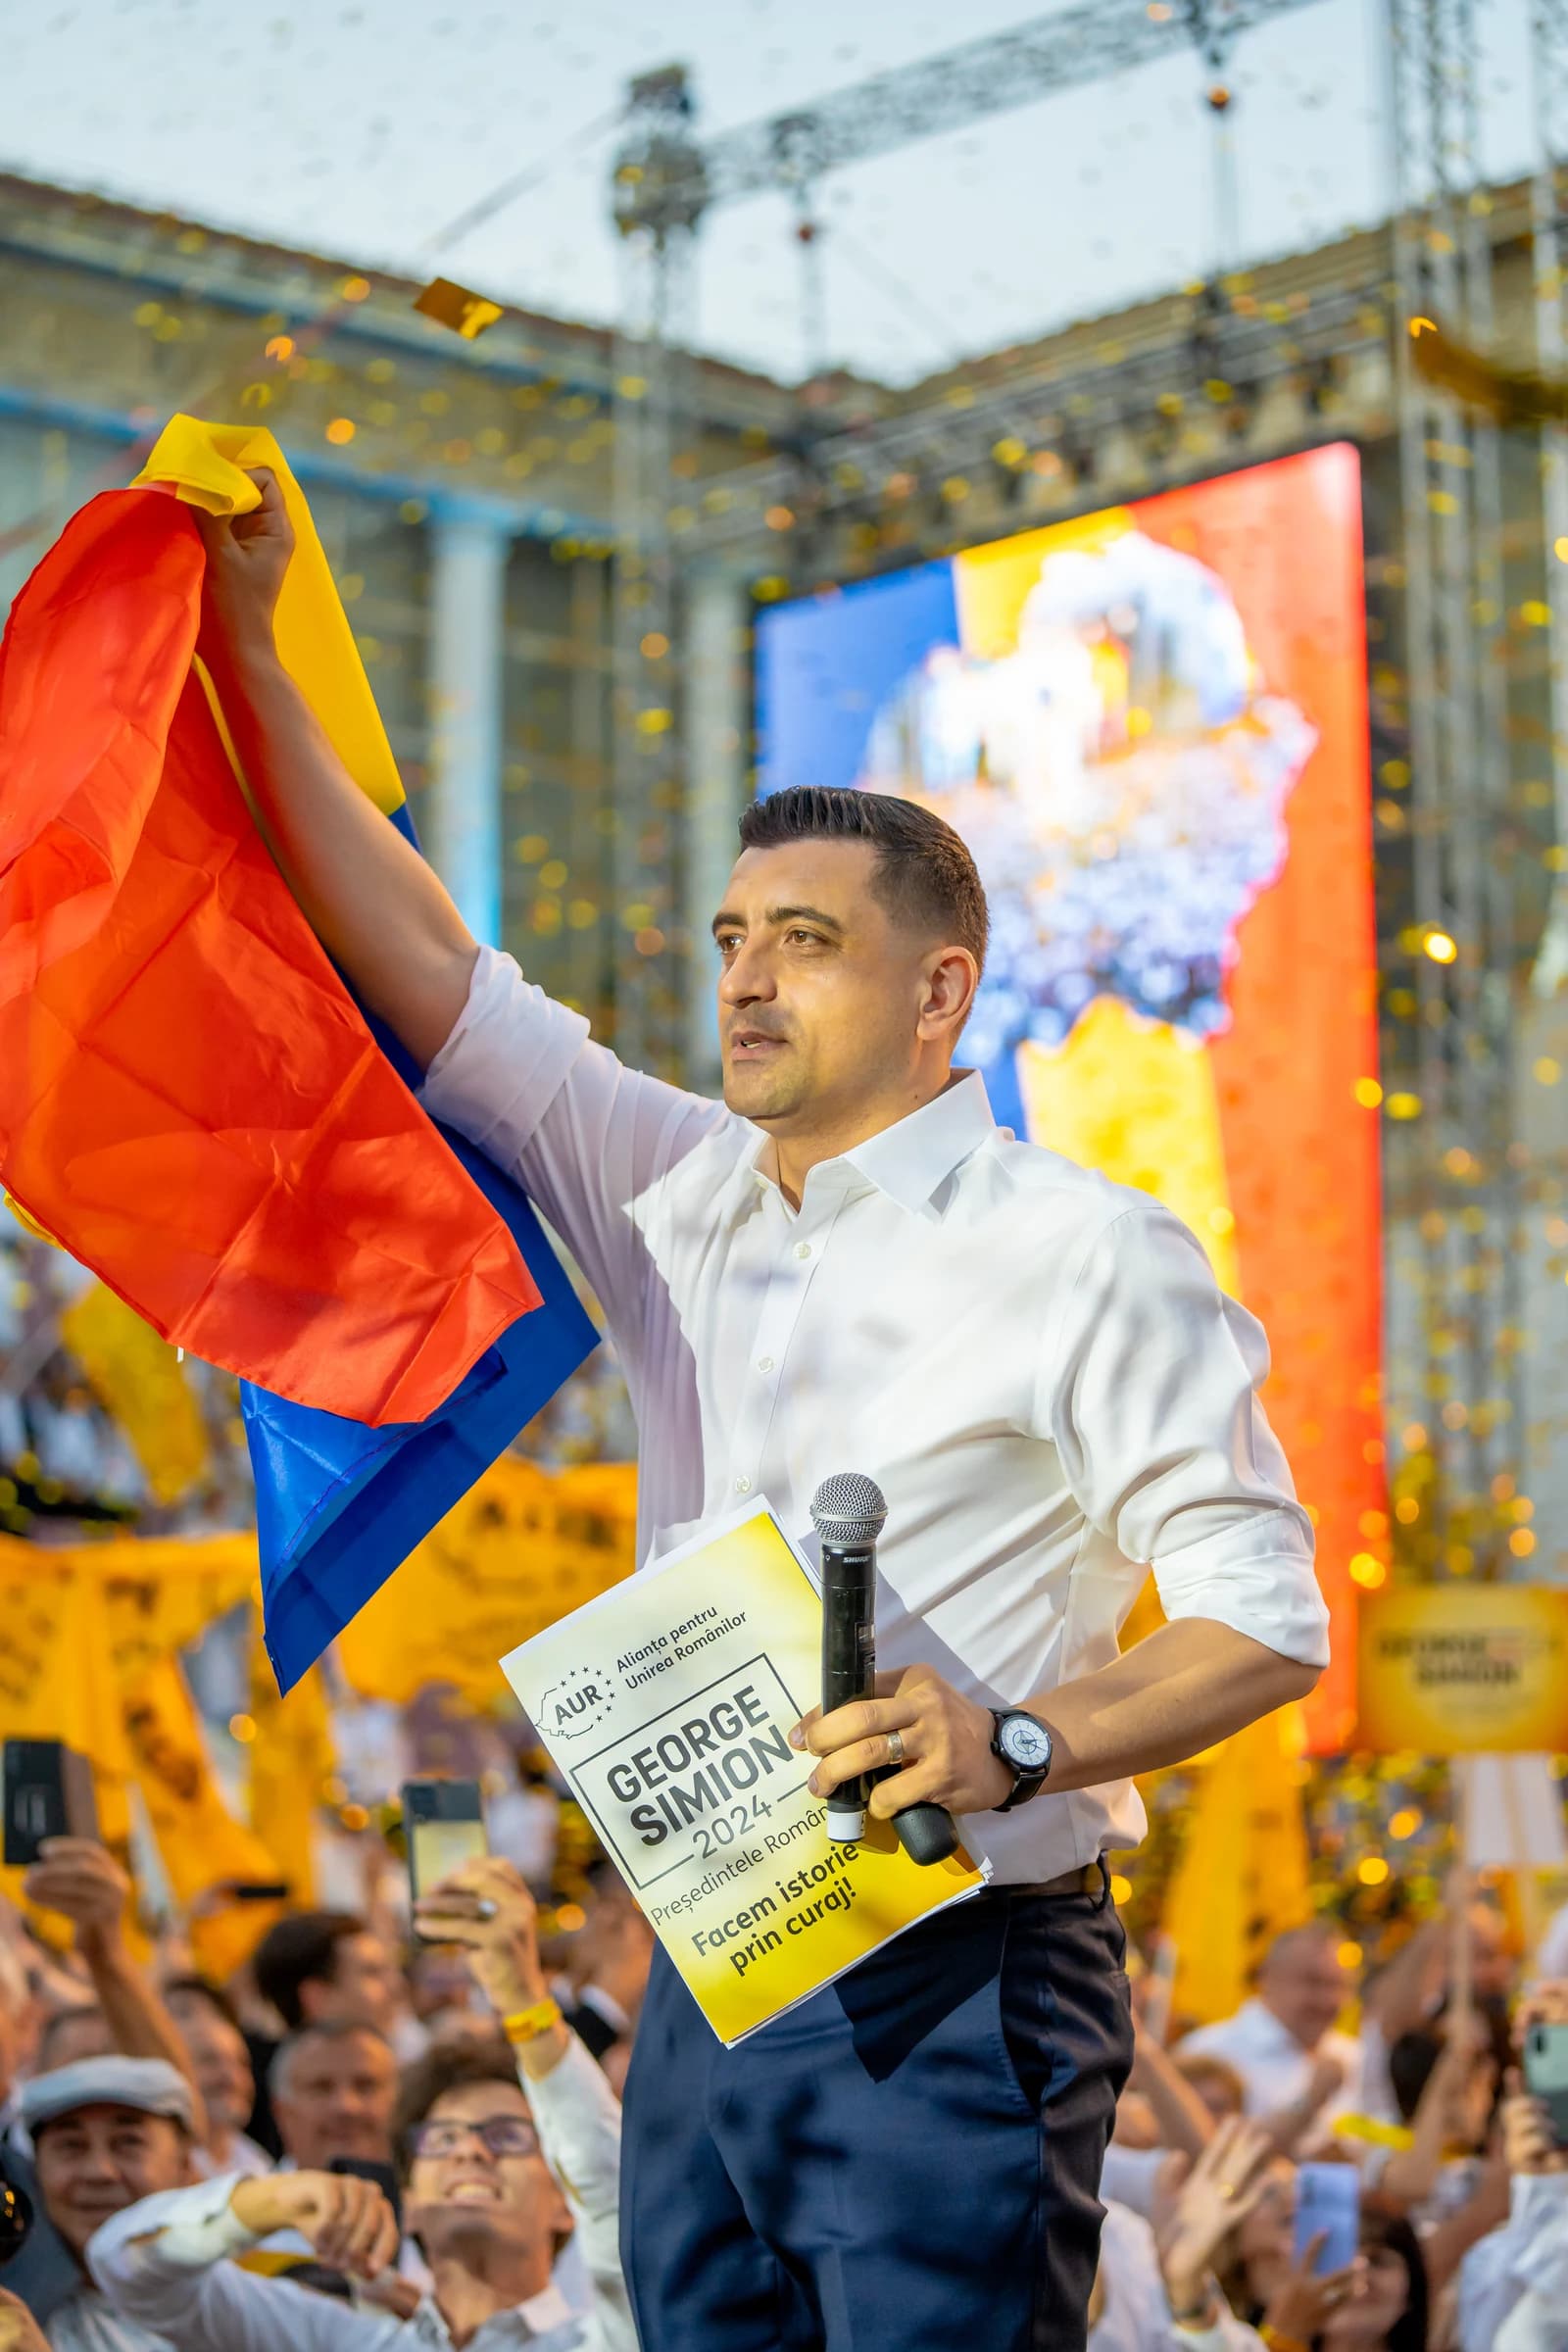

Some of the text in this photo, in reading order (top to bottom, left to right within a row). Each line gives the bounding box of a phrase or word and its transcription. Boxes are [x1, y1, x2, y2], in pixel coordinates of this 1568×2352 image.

[616, 1606, 717, 1673] Alianța pentru
[625, 1610, 748, 1690] Unirea Românilor
[554, 1684, 604, 1726] AUR
[607, 1685, 770, 1802] GEORGE
[630, 1724, 795, 1846] SIMION
[692, 1794, 772, 1859] 2024
[650, 1805, 828, 1927] Președintele Român
[691, 1843, 859, 1957] Facem istorie
[729, 1877, 857, 1977] prin curaj!
